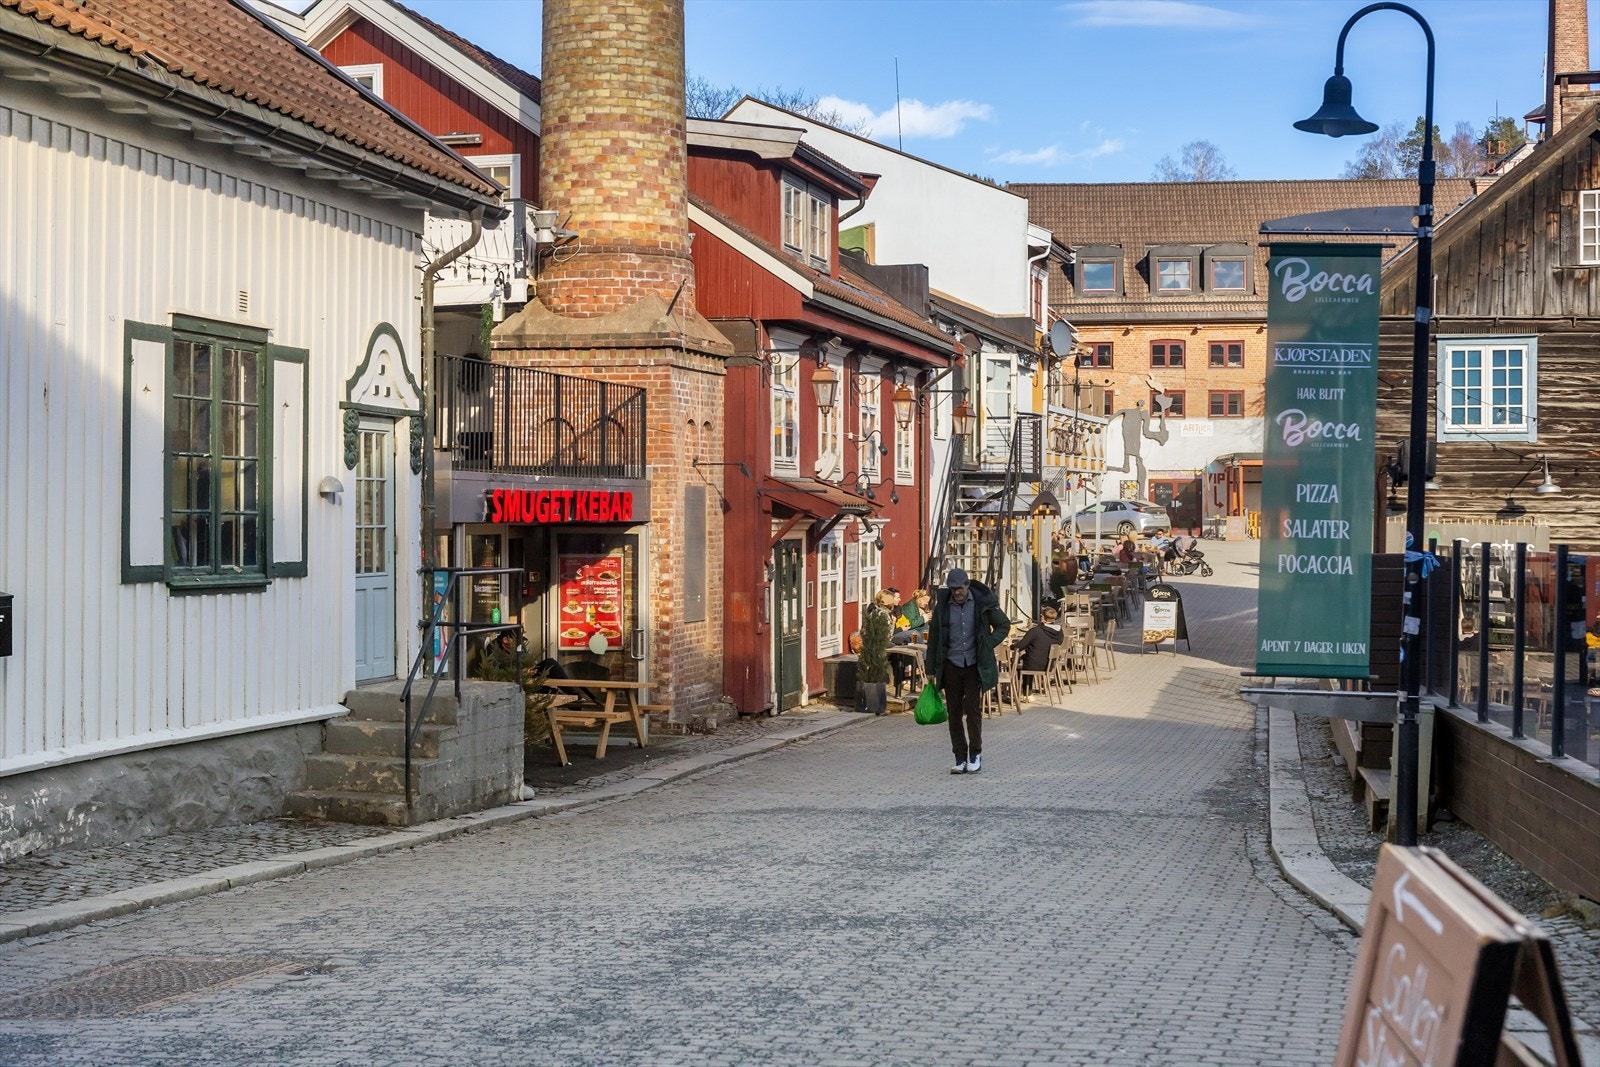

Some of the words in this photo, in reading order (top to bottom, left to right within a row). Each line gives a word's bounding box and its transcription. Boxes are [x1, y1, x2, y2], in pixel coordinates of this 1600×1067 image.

[1274, 257, 1375, 302] Bocca
[1274, 347, 1372, 363] KJØPSTADEN
[1297, 388, 1316, 400] HAR
[1319, 388, 1346, 401] BLITT
[1276, 408, 1362, 447] Bocca
[1296, 483, 1339, 504] PIZZA
[491, 488, 574, 524] SMUGET
[576, 490, 633, 522] KEBAB
[1283, 518, 1350, 540] SALATER
[1278, 554, 1353, 575] FOCACCIA
[1294, 641, 1301, 653] 7
[1304, 641, 1333, 654] DAGER
[1342, 642, 1366, 655] UKEN
